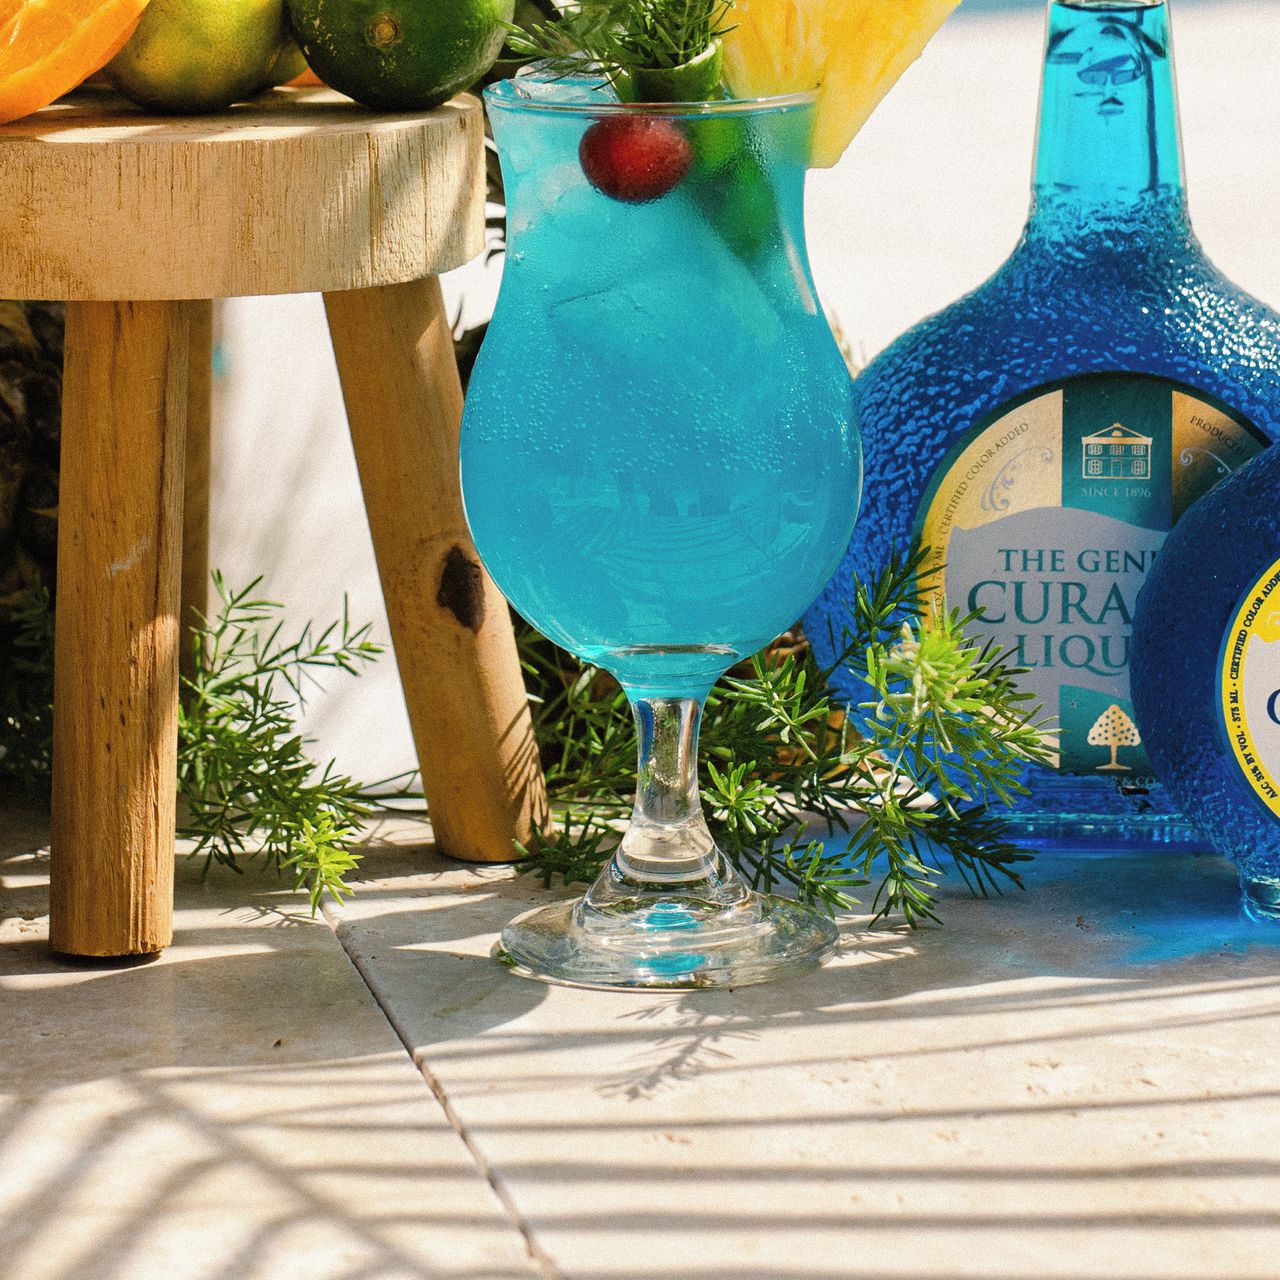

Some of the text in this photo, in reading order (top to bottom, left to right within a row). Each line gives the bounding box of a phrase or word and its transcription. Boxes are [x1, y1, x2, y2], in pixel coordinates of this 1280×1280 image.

[939, 481, 968, 535] CERTIFIED
[967, 448, 996, 481] COLOR
[995, 422, 1029, 452] ADDED
[1081, 487, 1151, 497] SINCE 1896
[998, 548, 1064, 572] THE
[967, 580, 1134, 625] CURA
[1243, 596, 1265, 628] COLOR
[1015, 634, 1130, 676] LIQU
[1230, 629, 1248, 679] CERTIFIED
[1230, 689, 1238, 704] ML
[1231, 706, 1241, 722] 375
[1236, 731, 1248, 751] VOL
[1243, 753, 1255, 765] BY
[1261, 782, 1278, 799] ALC
